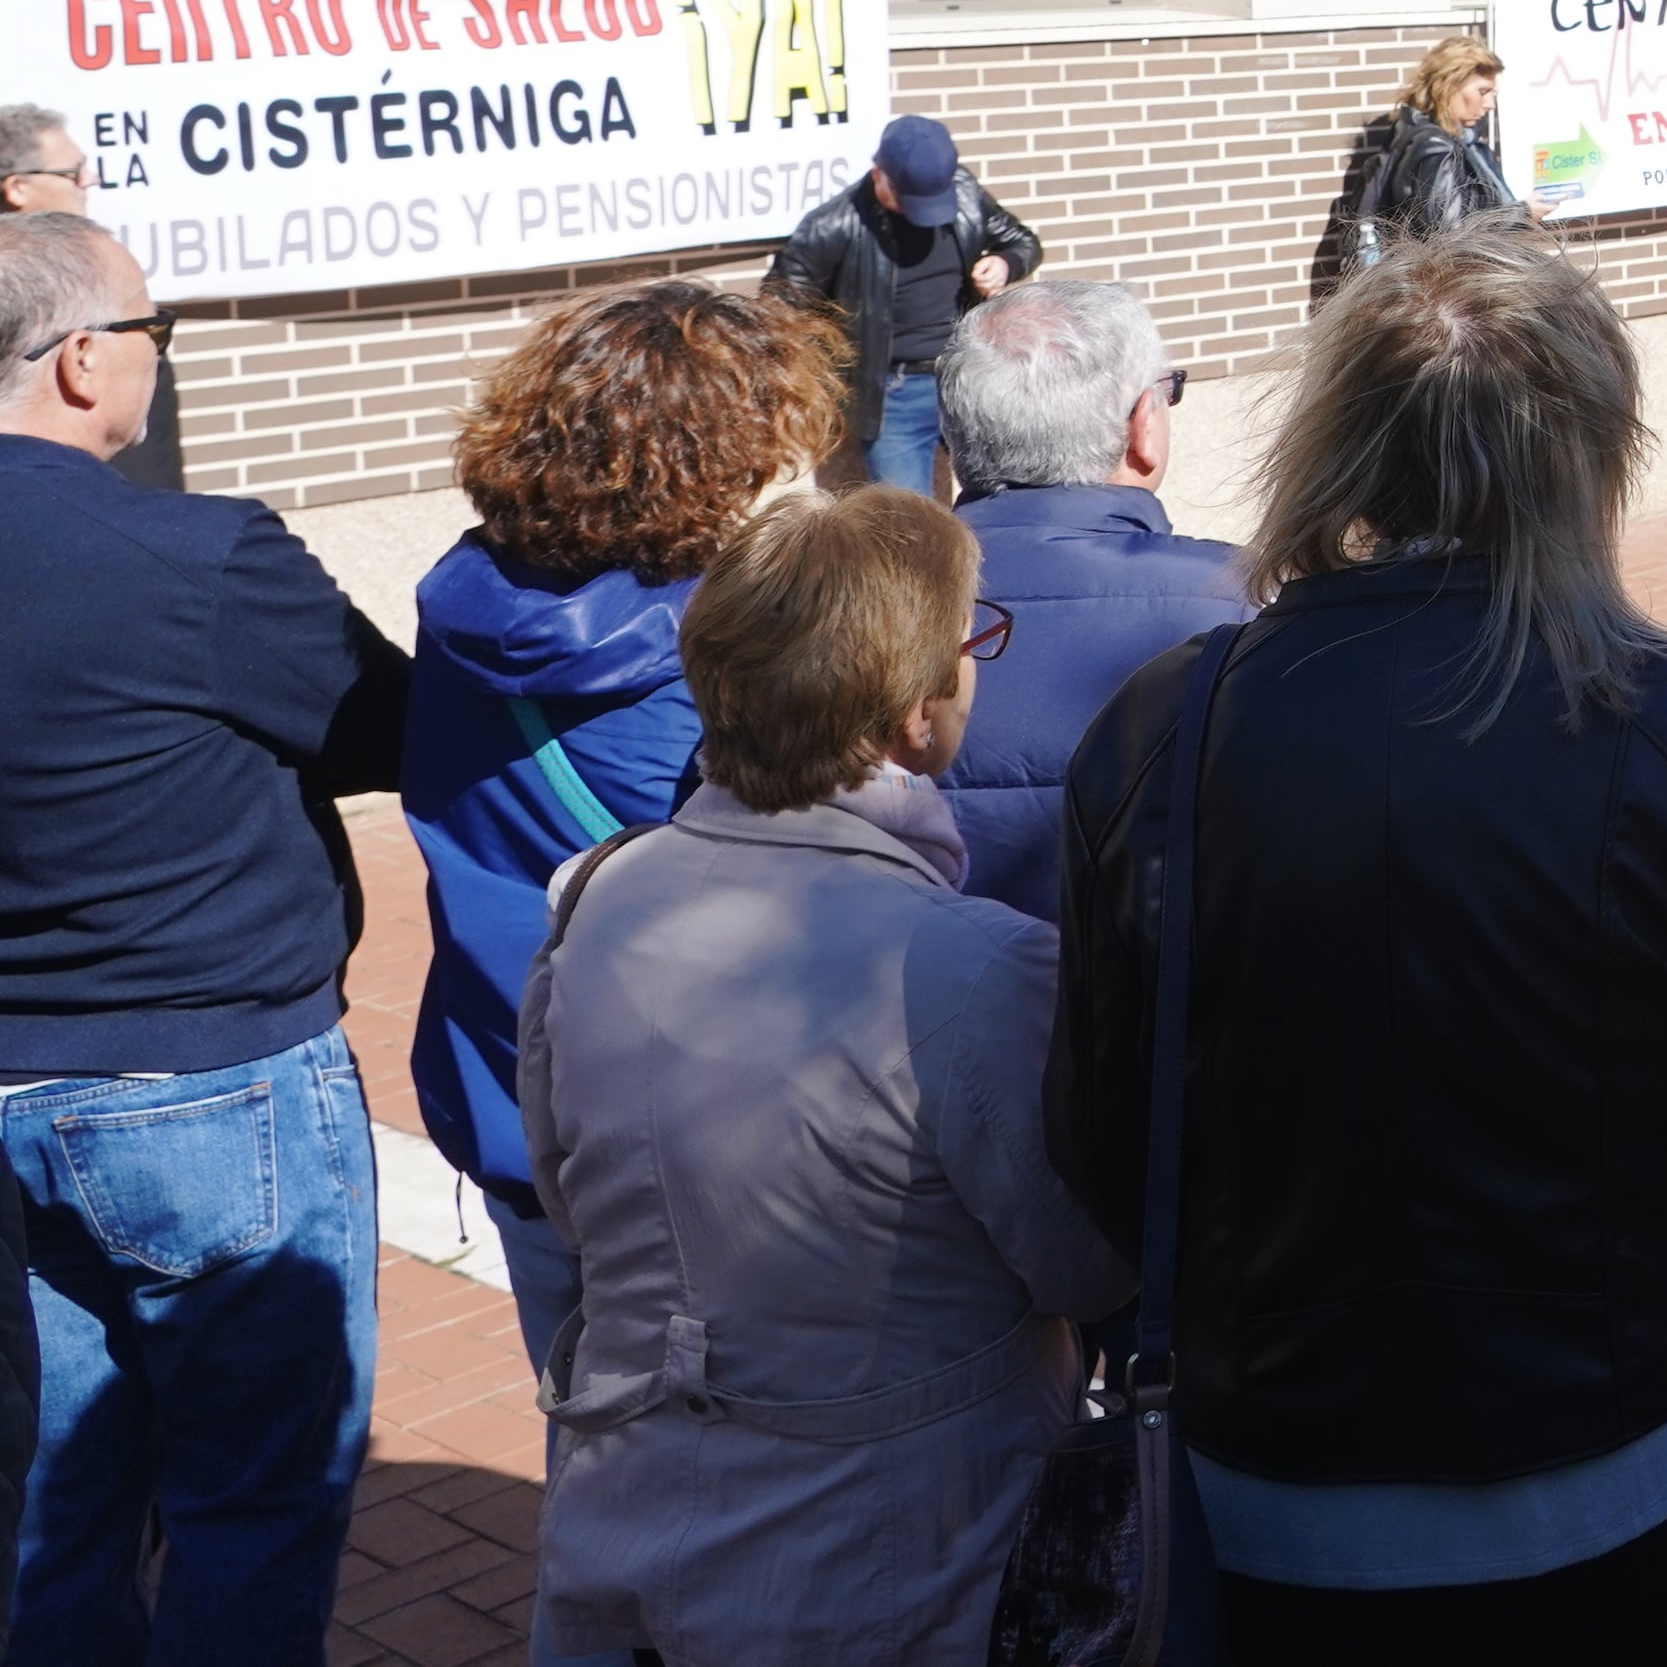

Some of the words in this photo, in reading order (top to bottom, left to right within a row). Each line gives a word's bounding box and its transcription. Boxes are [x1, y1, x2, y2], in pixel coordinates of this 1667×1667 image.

[95, 110, 148, 147] EN
[180, 69, 637, 175] CISTÉRNIGA
[97, 153, 150, 189] LA
[1552, 154, 1585, 170] Cister
[120, 199, 440, 279] UBILADOS
[461, 194, 495, 244] Y
[518, 156, 850, 241] PENSIONISTAS
